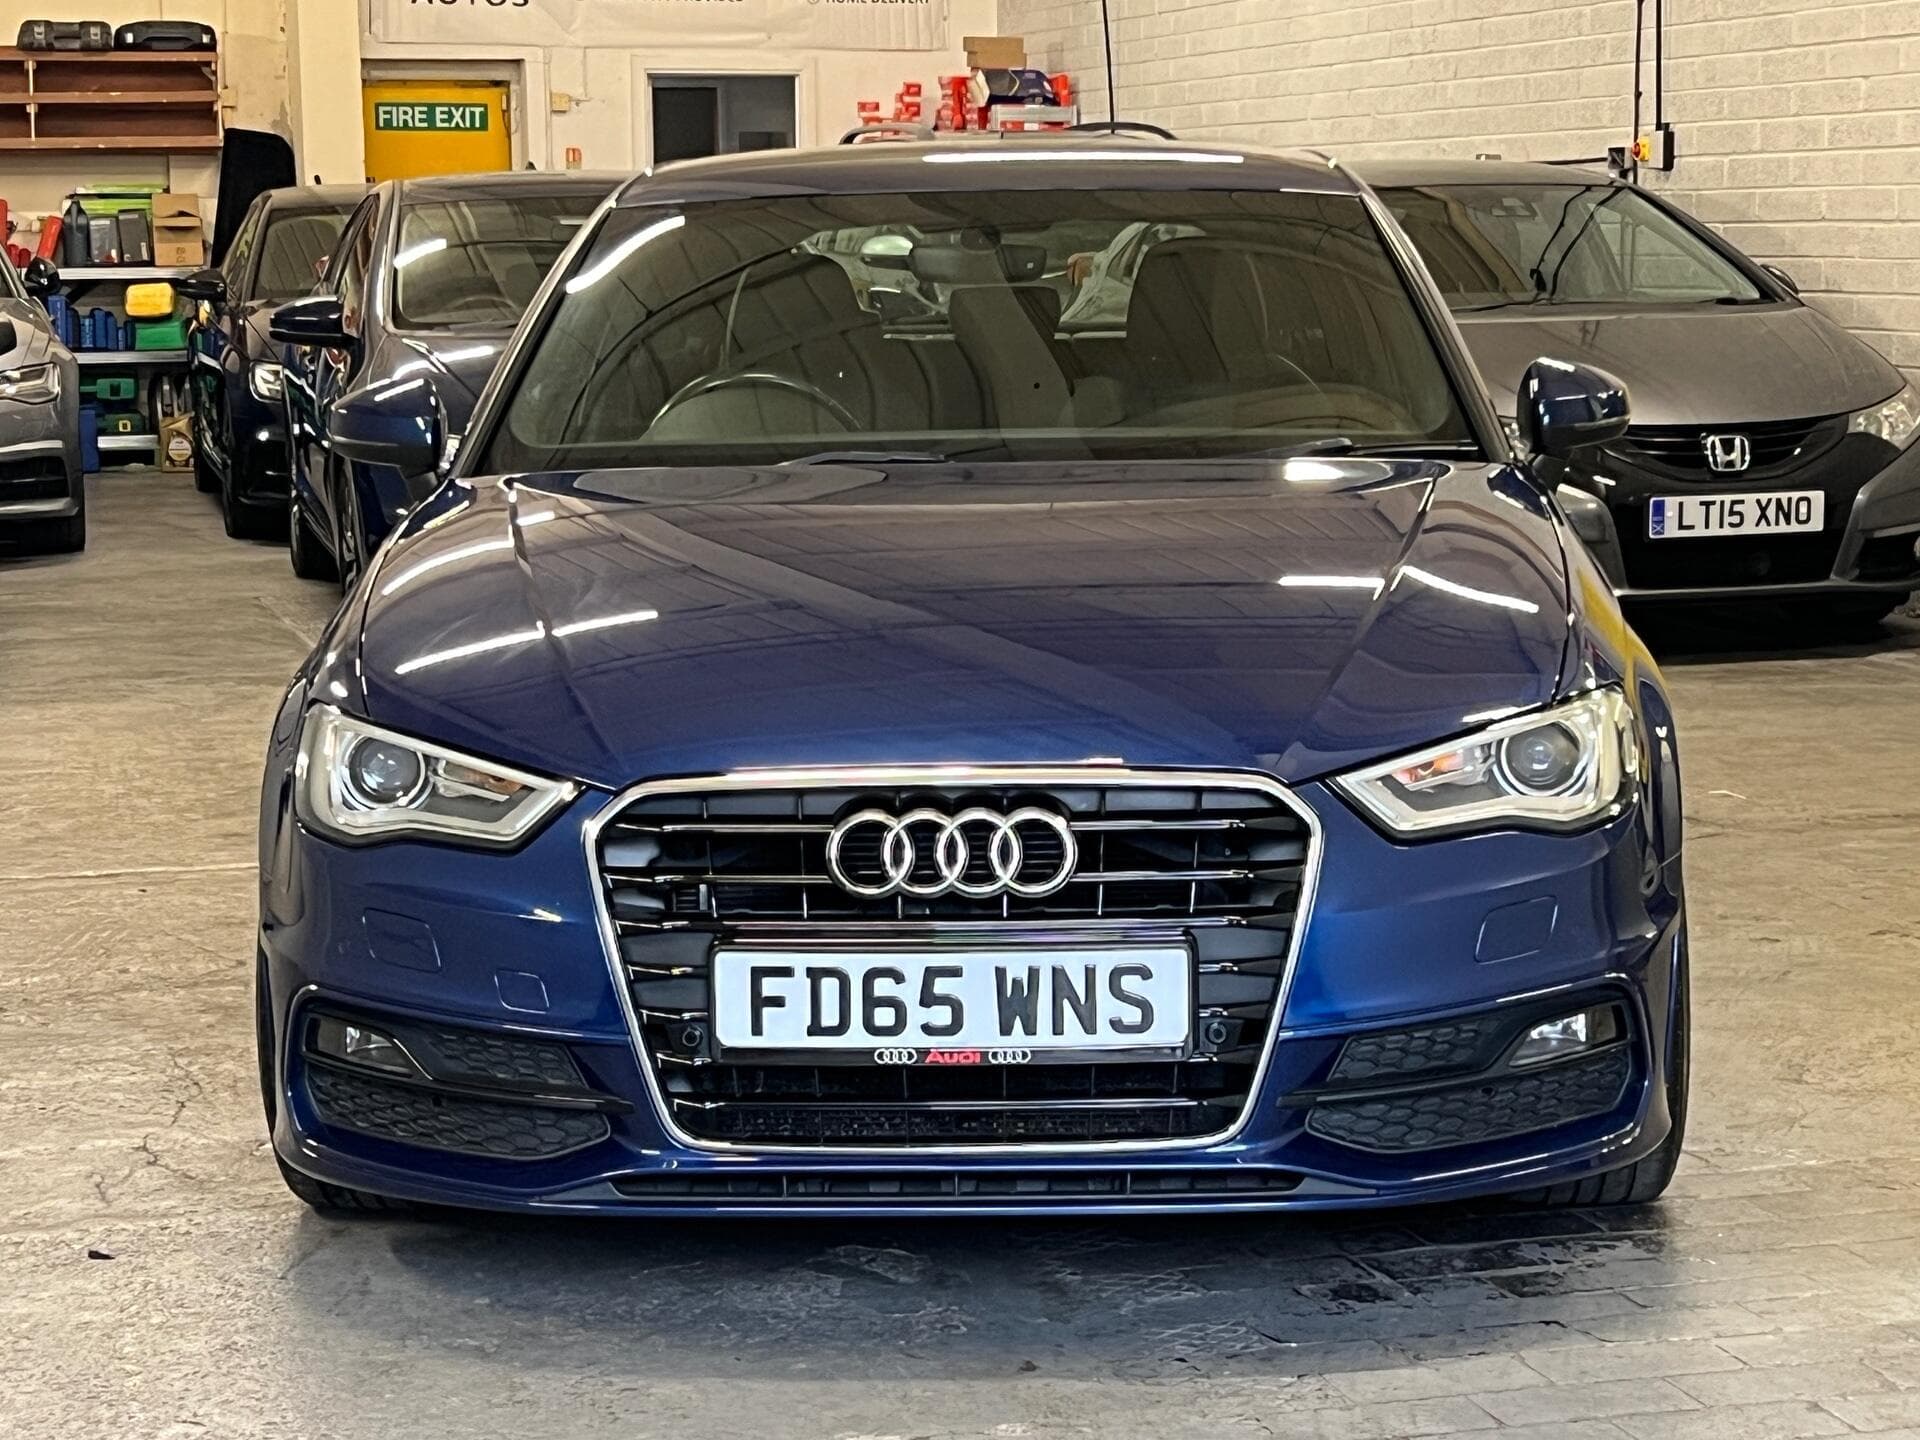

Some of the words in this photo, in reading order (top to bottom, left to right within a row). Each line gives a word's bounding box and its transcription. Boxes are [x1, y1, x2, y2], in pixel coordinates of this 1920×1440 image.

[378, 105, 429, 128] FIRE
[435, 106, 485, 128] EXIT
[1677, 499, 1745, 531] LT15
[1755, 496, 1812, 527] XNO
[750, 966, 964, 1037] FD65
[994, 963, 1154, 1035] WNS
